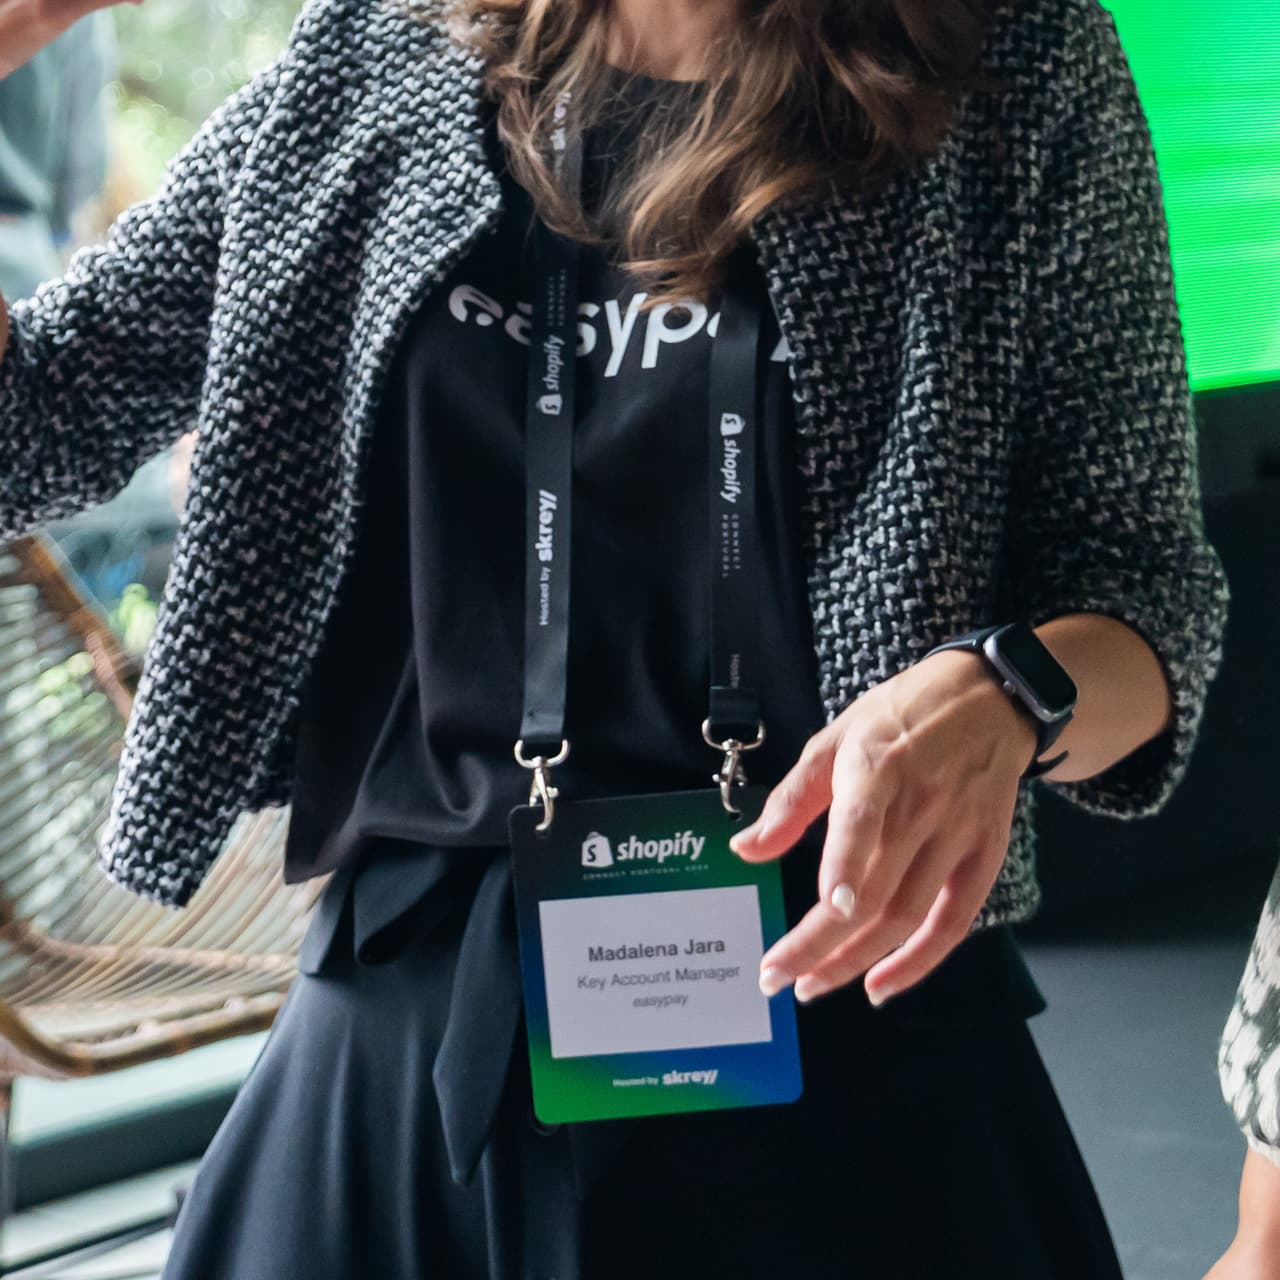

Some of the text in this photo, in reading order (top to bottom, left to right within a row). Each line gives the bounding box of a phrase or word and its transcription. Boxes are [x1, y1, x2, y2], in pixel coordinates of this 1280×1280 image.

[542, 334, 567, 392] shopify
[720, 438, 743, 504] shopify
[616, 830, 706, 864] shopify
[588, 938, 726, 963] Madalena Jara
[577, 964, 741, 991] Key Account Manager
[632, 992, 689, 1009] easypay
